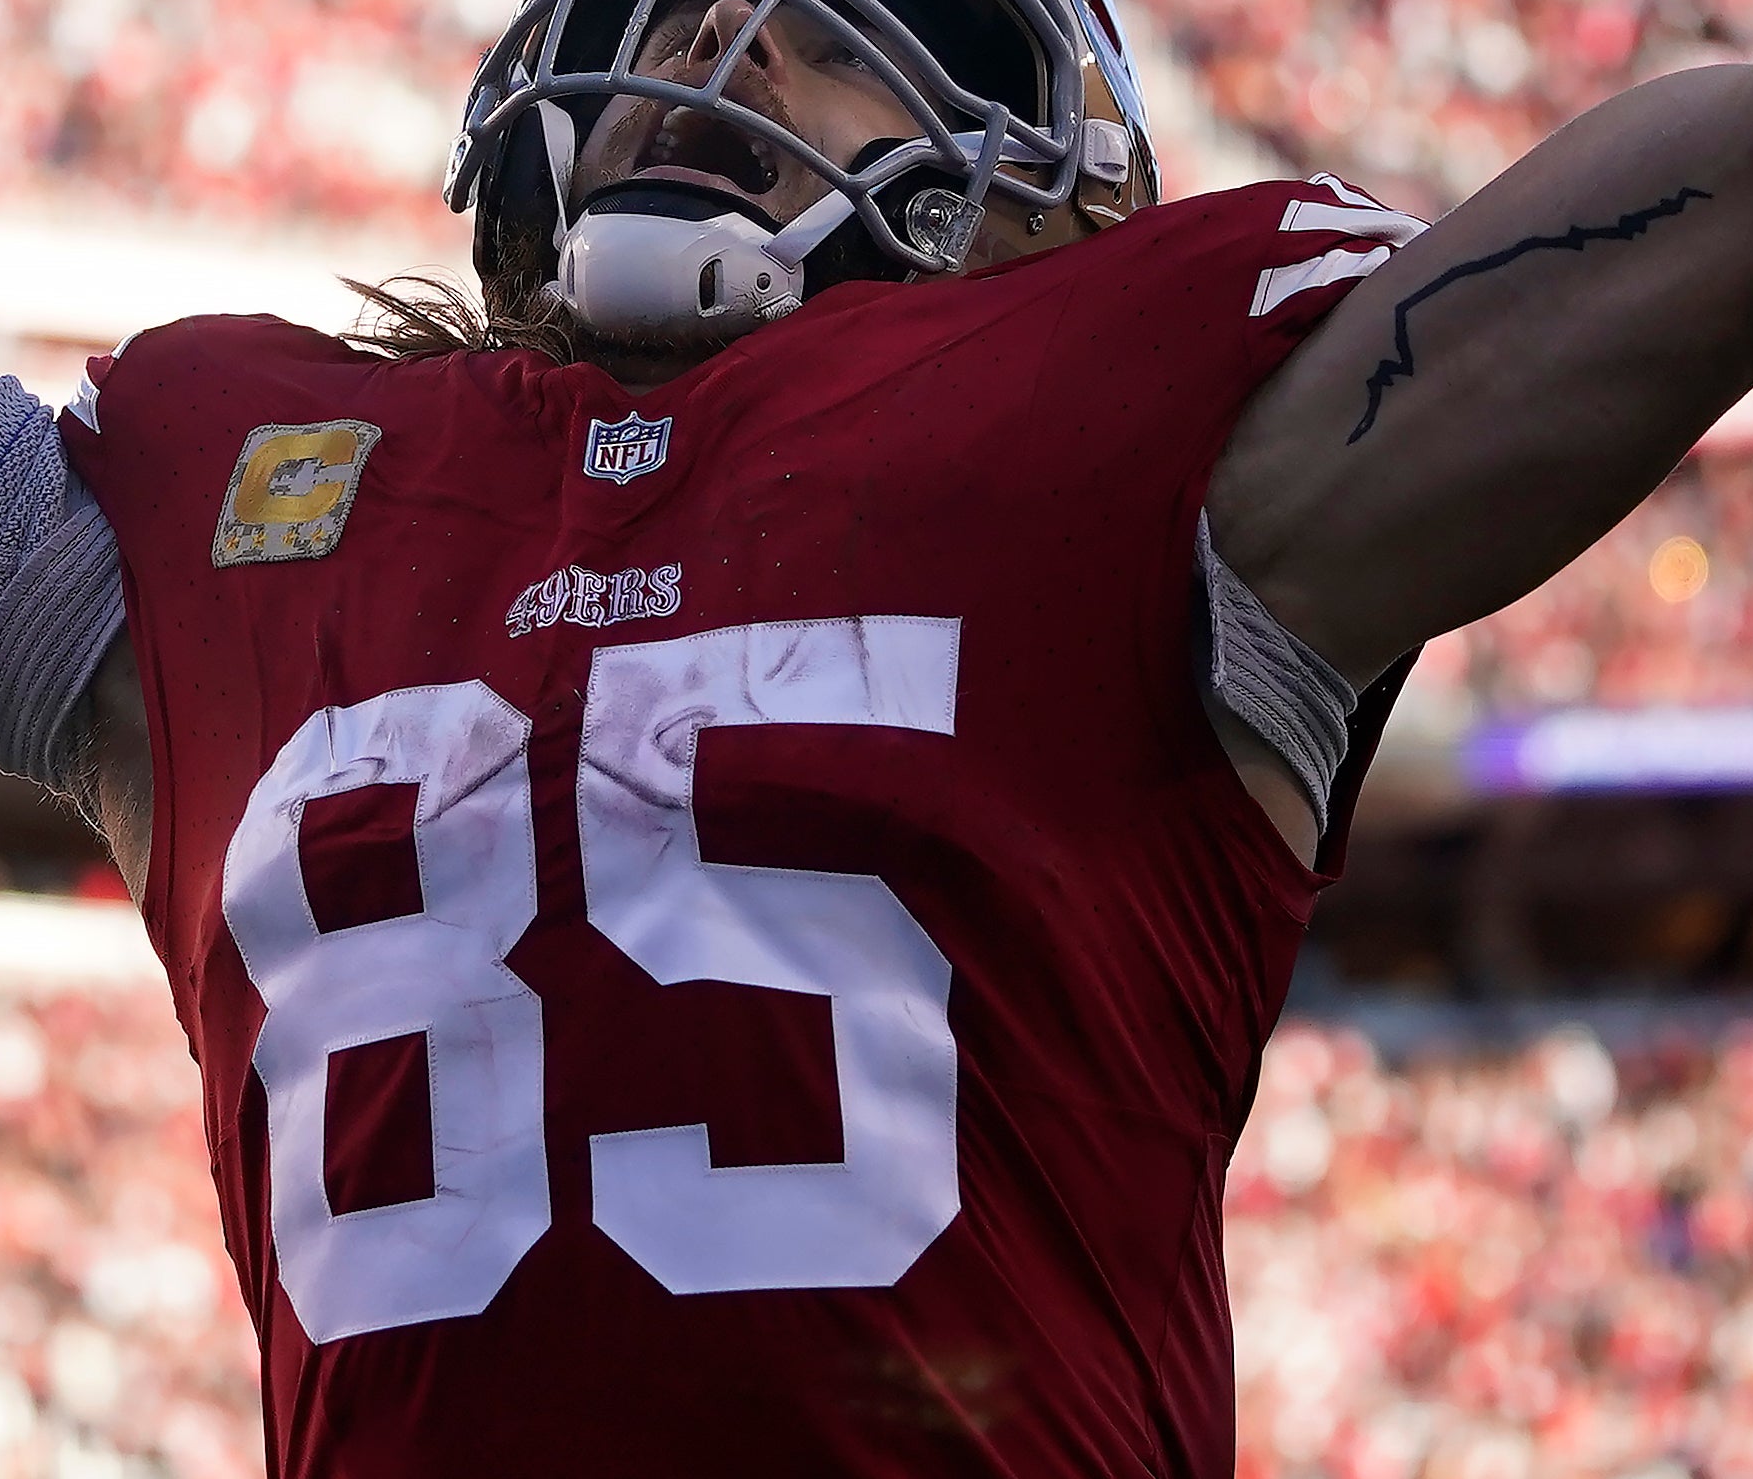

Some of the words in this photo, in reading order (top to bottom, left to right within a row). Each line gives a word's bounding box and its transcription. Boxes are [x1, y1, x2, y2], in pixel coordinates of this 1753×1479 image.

[234, 429, 359, 525] C
[597, 441, 653, 470] NFL
[505, 562, 683, 638] 49ERS
[221, 616, 963, 1346] 85
